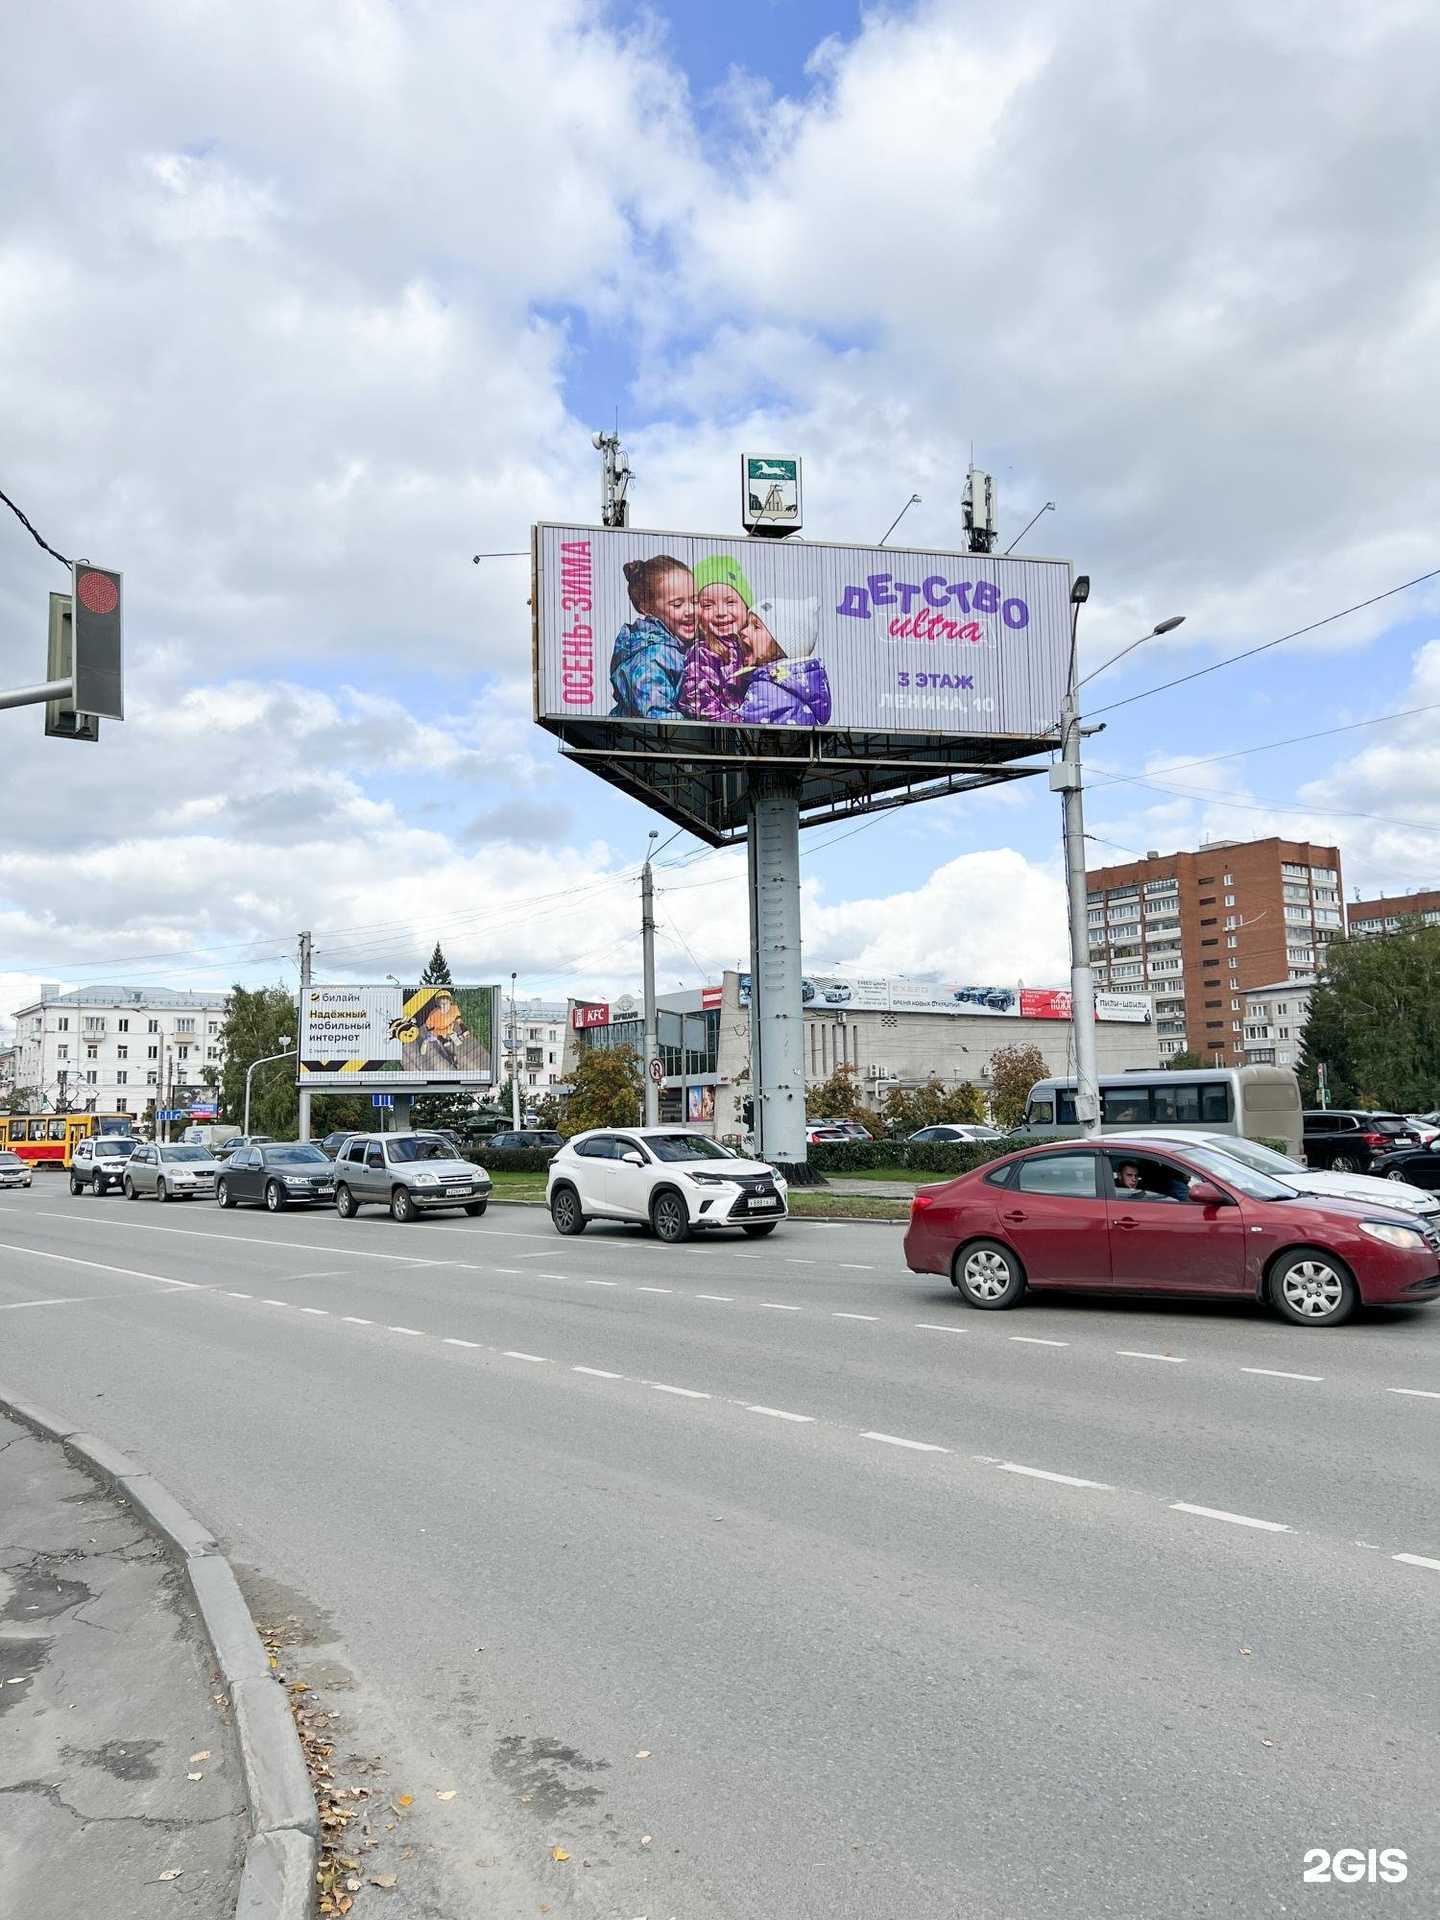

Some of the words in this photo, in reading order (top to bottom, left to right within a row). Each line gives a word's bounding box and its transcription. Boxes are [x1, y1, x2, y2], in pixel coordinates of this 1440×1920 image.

[836, 573, 1030, 630] ДЕТСТВО
[560, 540, 594, 705] ОСЕНЬ-ЗИМА
[888, 607, 983, 642] ultra
[897, 671, 910, 688] 3
[915, 672, 975, 690] ЭТАЖ
[878, 692, 969, 713] ЛЕНИНА,
[322, 992, 360, 1002] билайн
[587, 1008, 604, 1021] KFC
[309, 1021, 371, 1031] мобильный
[309, 1034, 360, 1043] интернет
